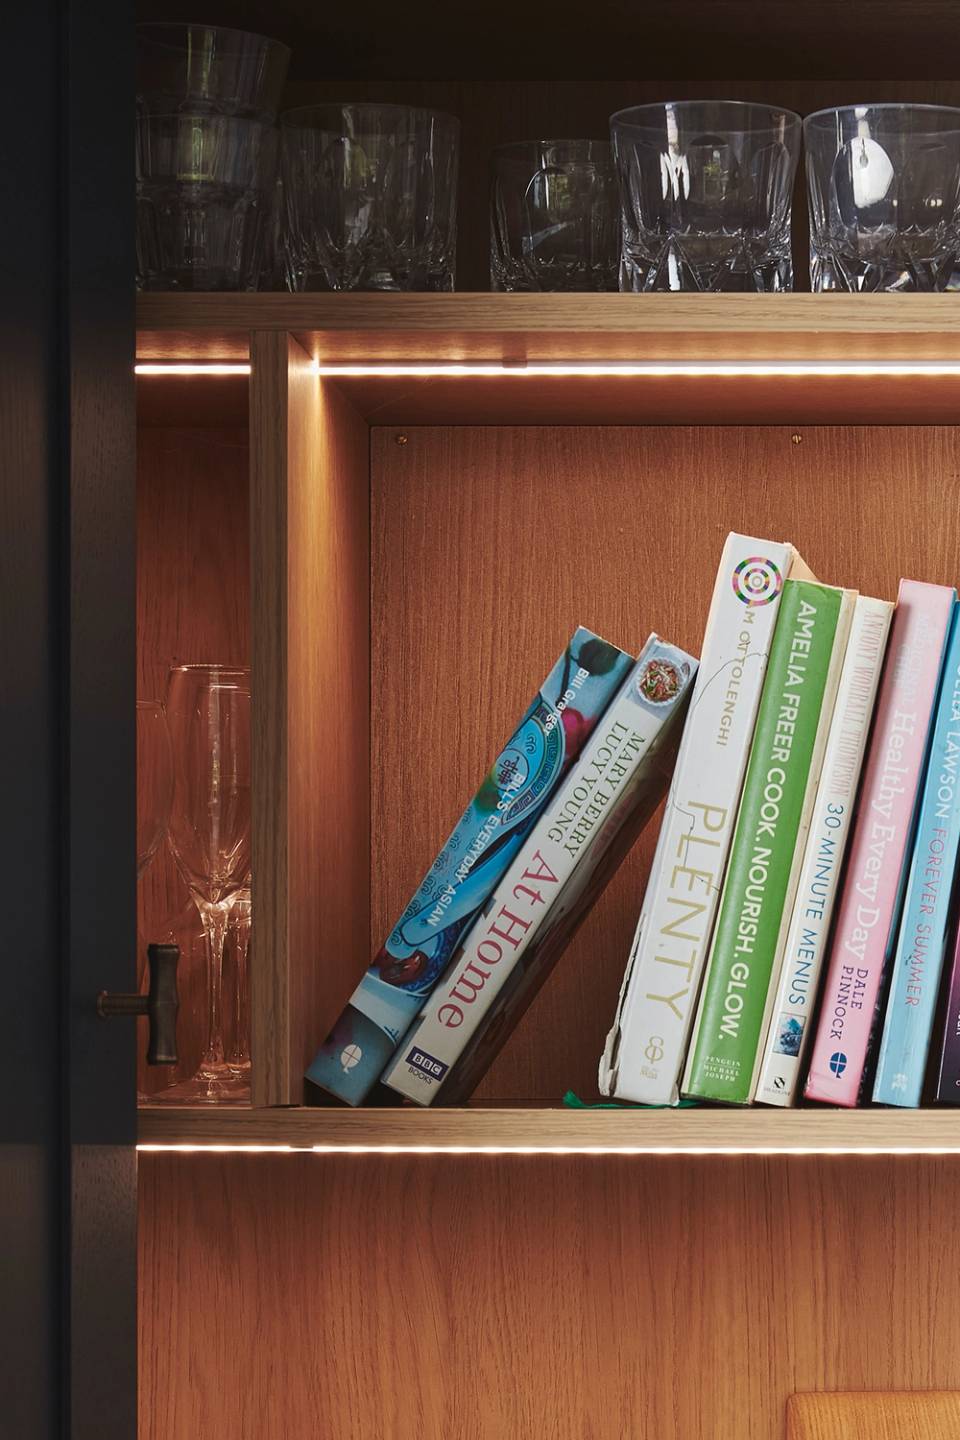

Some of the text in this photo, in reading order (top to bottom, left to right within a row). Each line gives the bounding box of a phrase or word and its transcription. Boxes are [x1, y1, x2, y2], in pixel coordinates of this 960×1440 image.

[543, 667, 590, 736] Bill Granger
[716, 631, 753, 746] OTTOLENGHI
[548, 720, 628, 843] LUCY YOUNG
[563, 732, 645, 859] MARY BERRY
[933, 732, 960, 818] LAWSON
[426, 774, 526, 927] BILL'S EVERYDAY ASIAN
[718, 600, 817, 1040] AMELIA FREER COOK. NOURISH. GLOW.
[806, 803, 844, 921] 30-MINUTE
[844, 710, 916, 961] Healthy Every Day
[646, 800, 728, 1020] PLENTY
[919, 828, 947, 914] FOREVER
[437, 850, 560, 1029] At Home
[788, 928, 817, 1006] MENUS
[905, 924, 931, 1007] SUMMER
[829, 966, 854, 1039] PINNOCK
[850, 969, 868, 1010] DALE
[408, 1067, 433, 1085] BOOKS
[412, 1053, 443, 1075] BBC
[703, 1065, 740, 1076] MICHAEL
[705, 1056, 741, 1066] PENGUIN
[705, 1073, 736, 1082] JOSEPH
